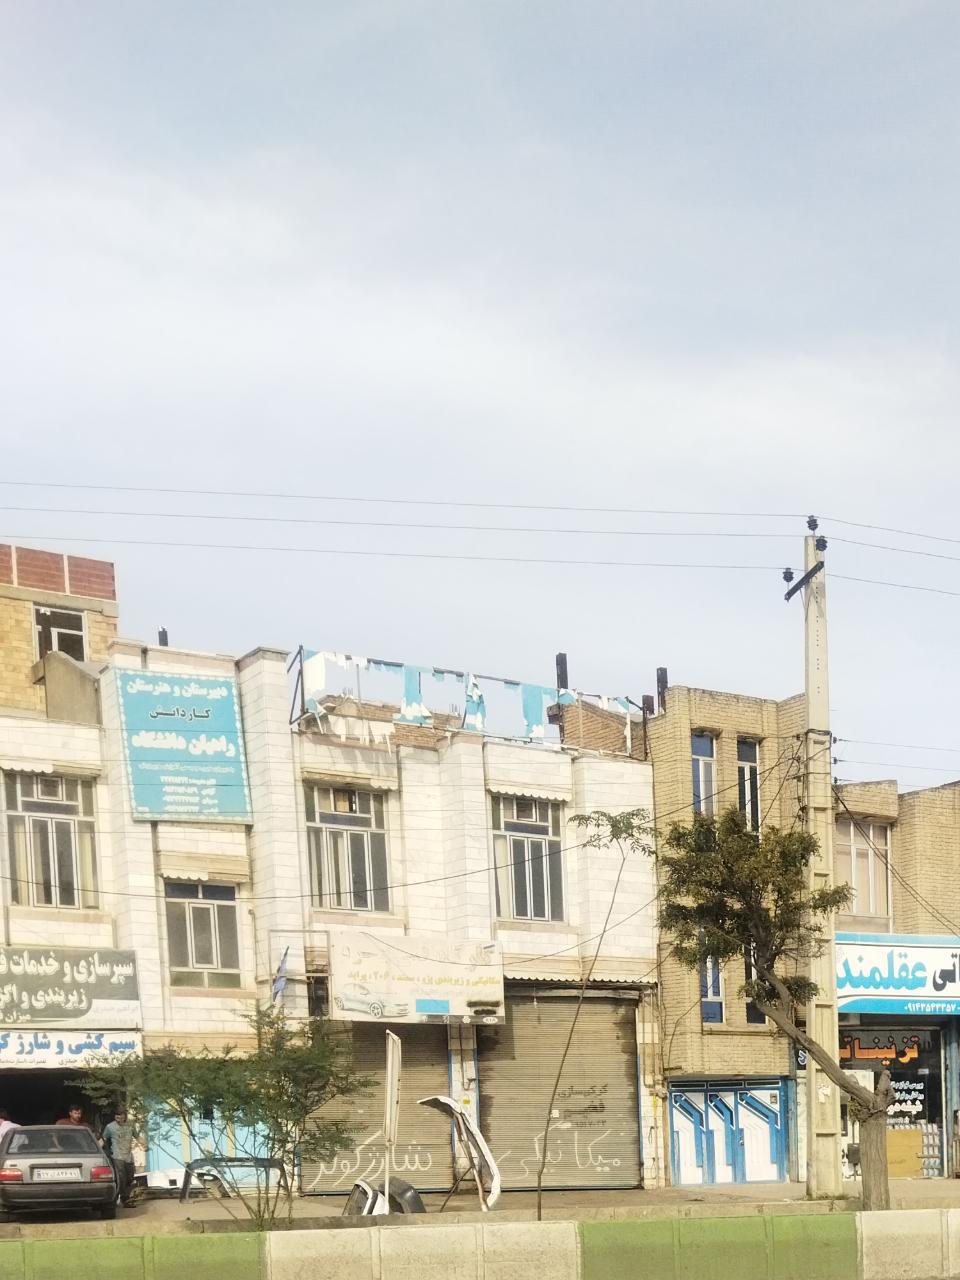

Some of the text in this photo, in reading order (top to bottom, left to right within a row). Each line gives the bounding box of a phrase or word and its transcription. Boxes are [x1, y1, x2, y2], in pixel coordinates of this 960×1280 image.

[173, 685, 181, 697] و
[9, 949, 60, 976] خدمات
[62, 960, 72, 984] و
[836, 949, 928, 991] عقلمند
[20, 991, 30, 1010] و
[31, 986, 89, 1010] زیربندی
[16, 1032, 51, 1055] شارژ
[55, 1039, 65, 1055] و
[68, 1032, 105, 1055] کشی
[839, 1035, 921, 1067] تزئینات
